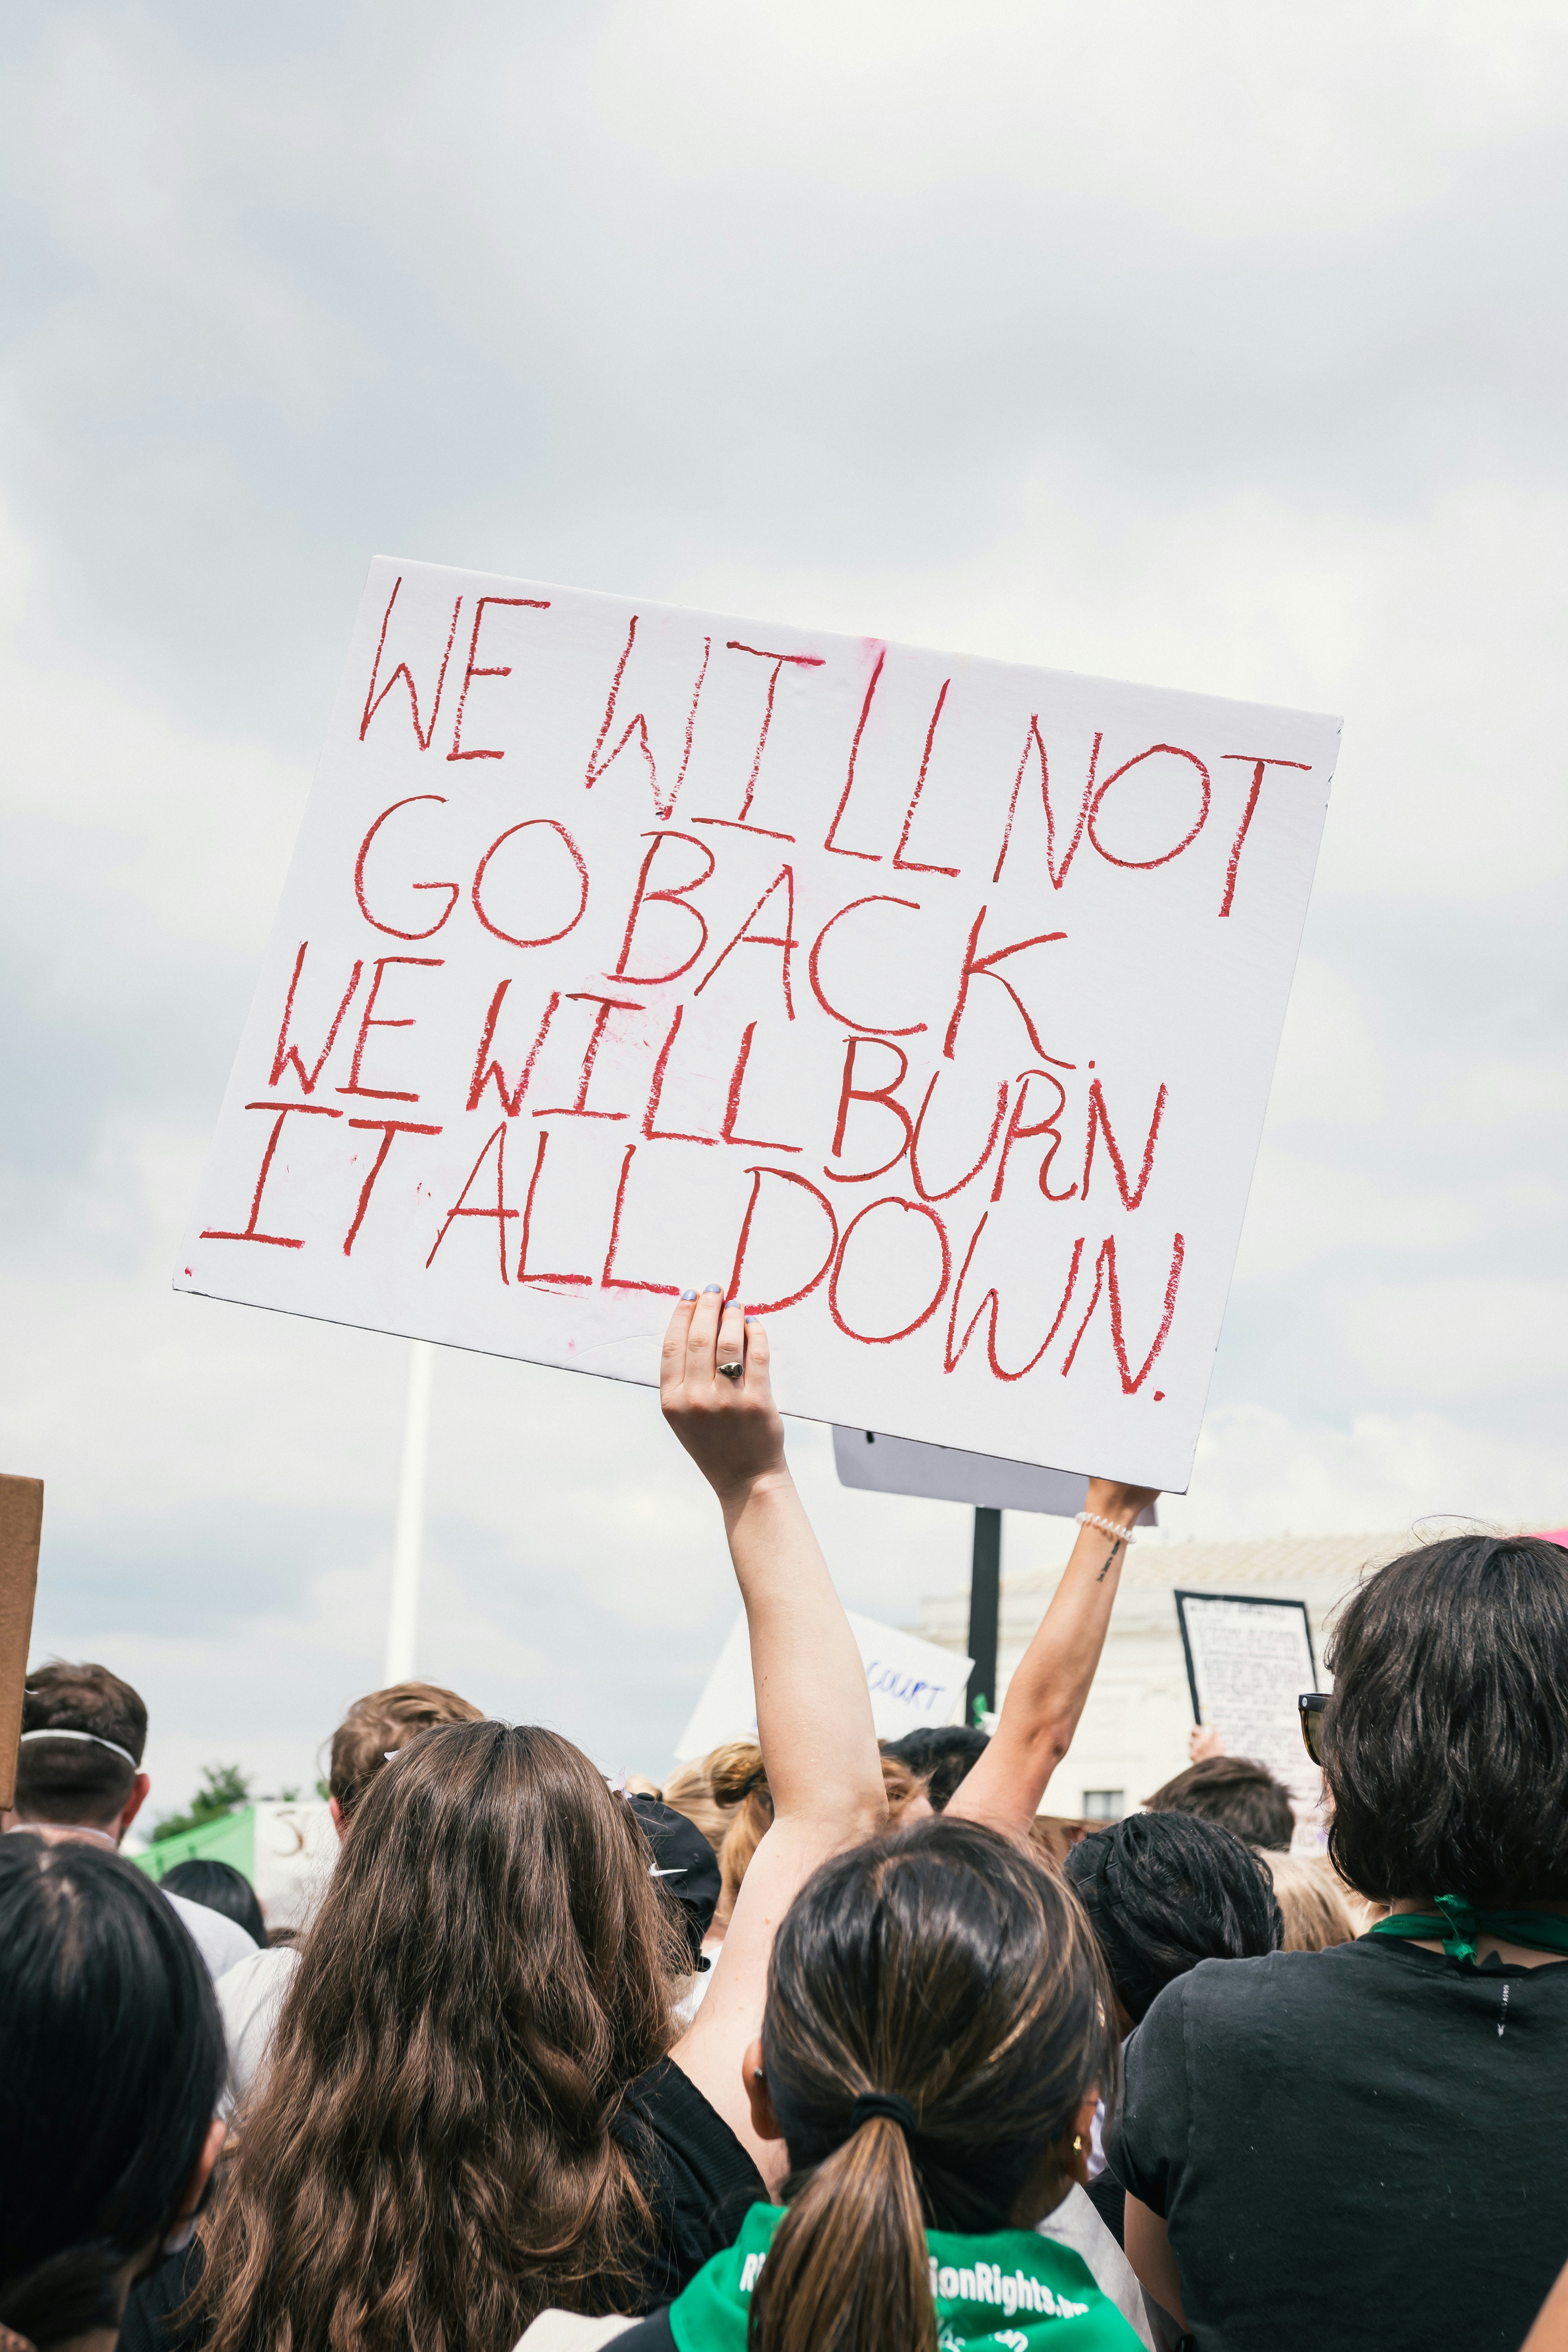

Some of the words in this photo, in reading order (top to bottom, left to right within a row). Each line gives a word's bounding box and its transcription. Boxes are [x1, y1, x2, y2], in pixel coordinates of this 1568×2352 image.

[358, 577, 551, 761] WE
[584, 615, 961, 878] WILL
[992, 713, 1312, 918] NOT
[354, 795, 589, 949] GO
[606, 830, 1096, 1071] BACK.
[268, 941, 445, 1103] WE
[466, 979, 803, 1153] WILL
[823, 1035, 1168, 1212] BURN
[199, 1102, 443, 1257] IT
[425, 1121, 681, 1296] ALL
[722, 1166, 1185, 1402] DOWN.
[866, 1661, 946, 1710] COURT
